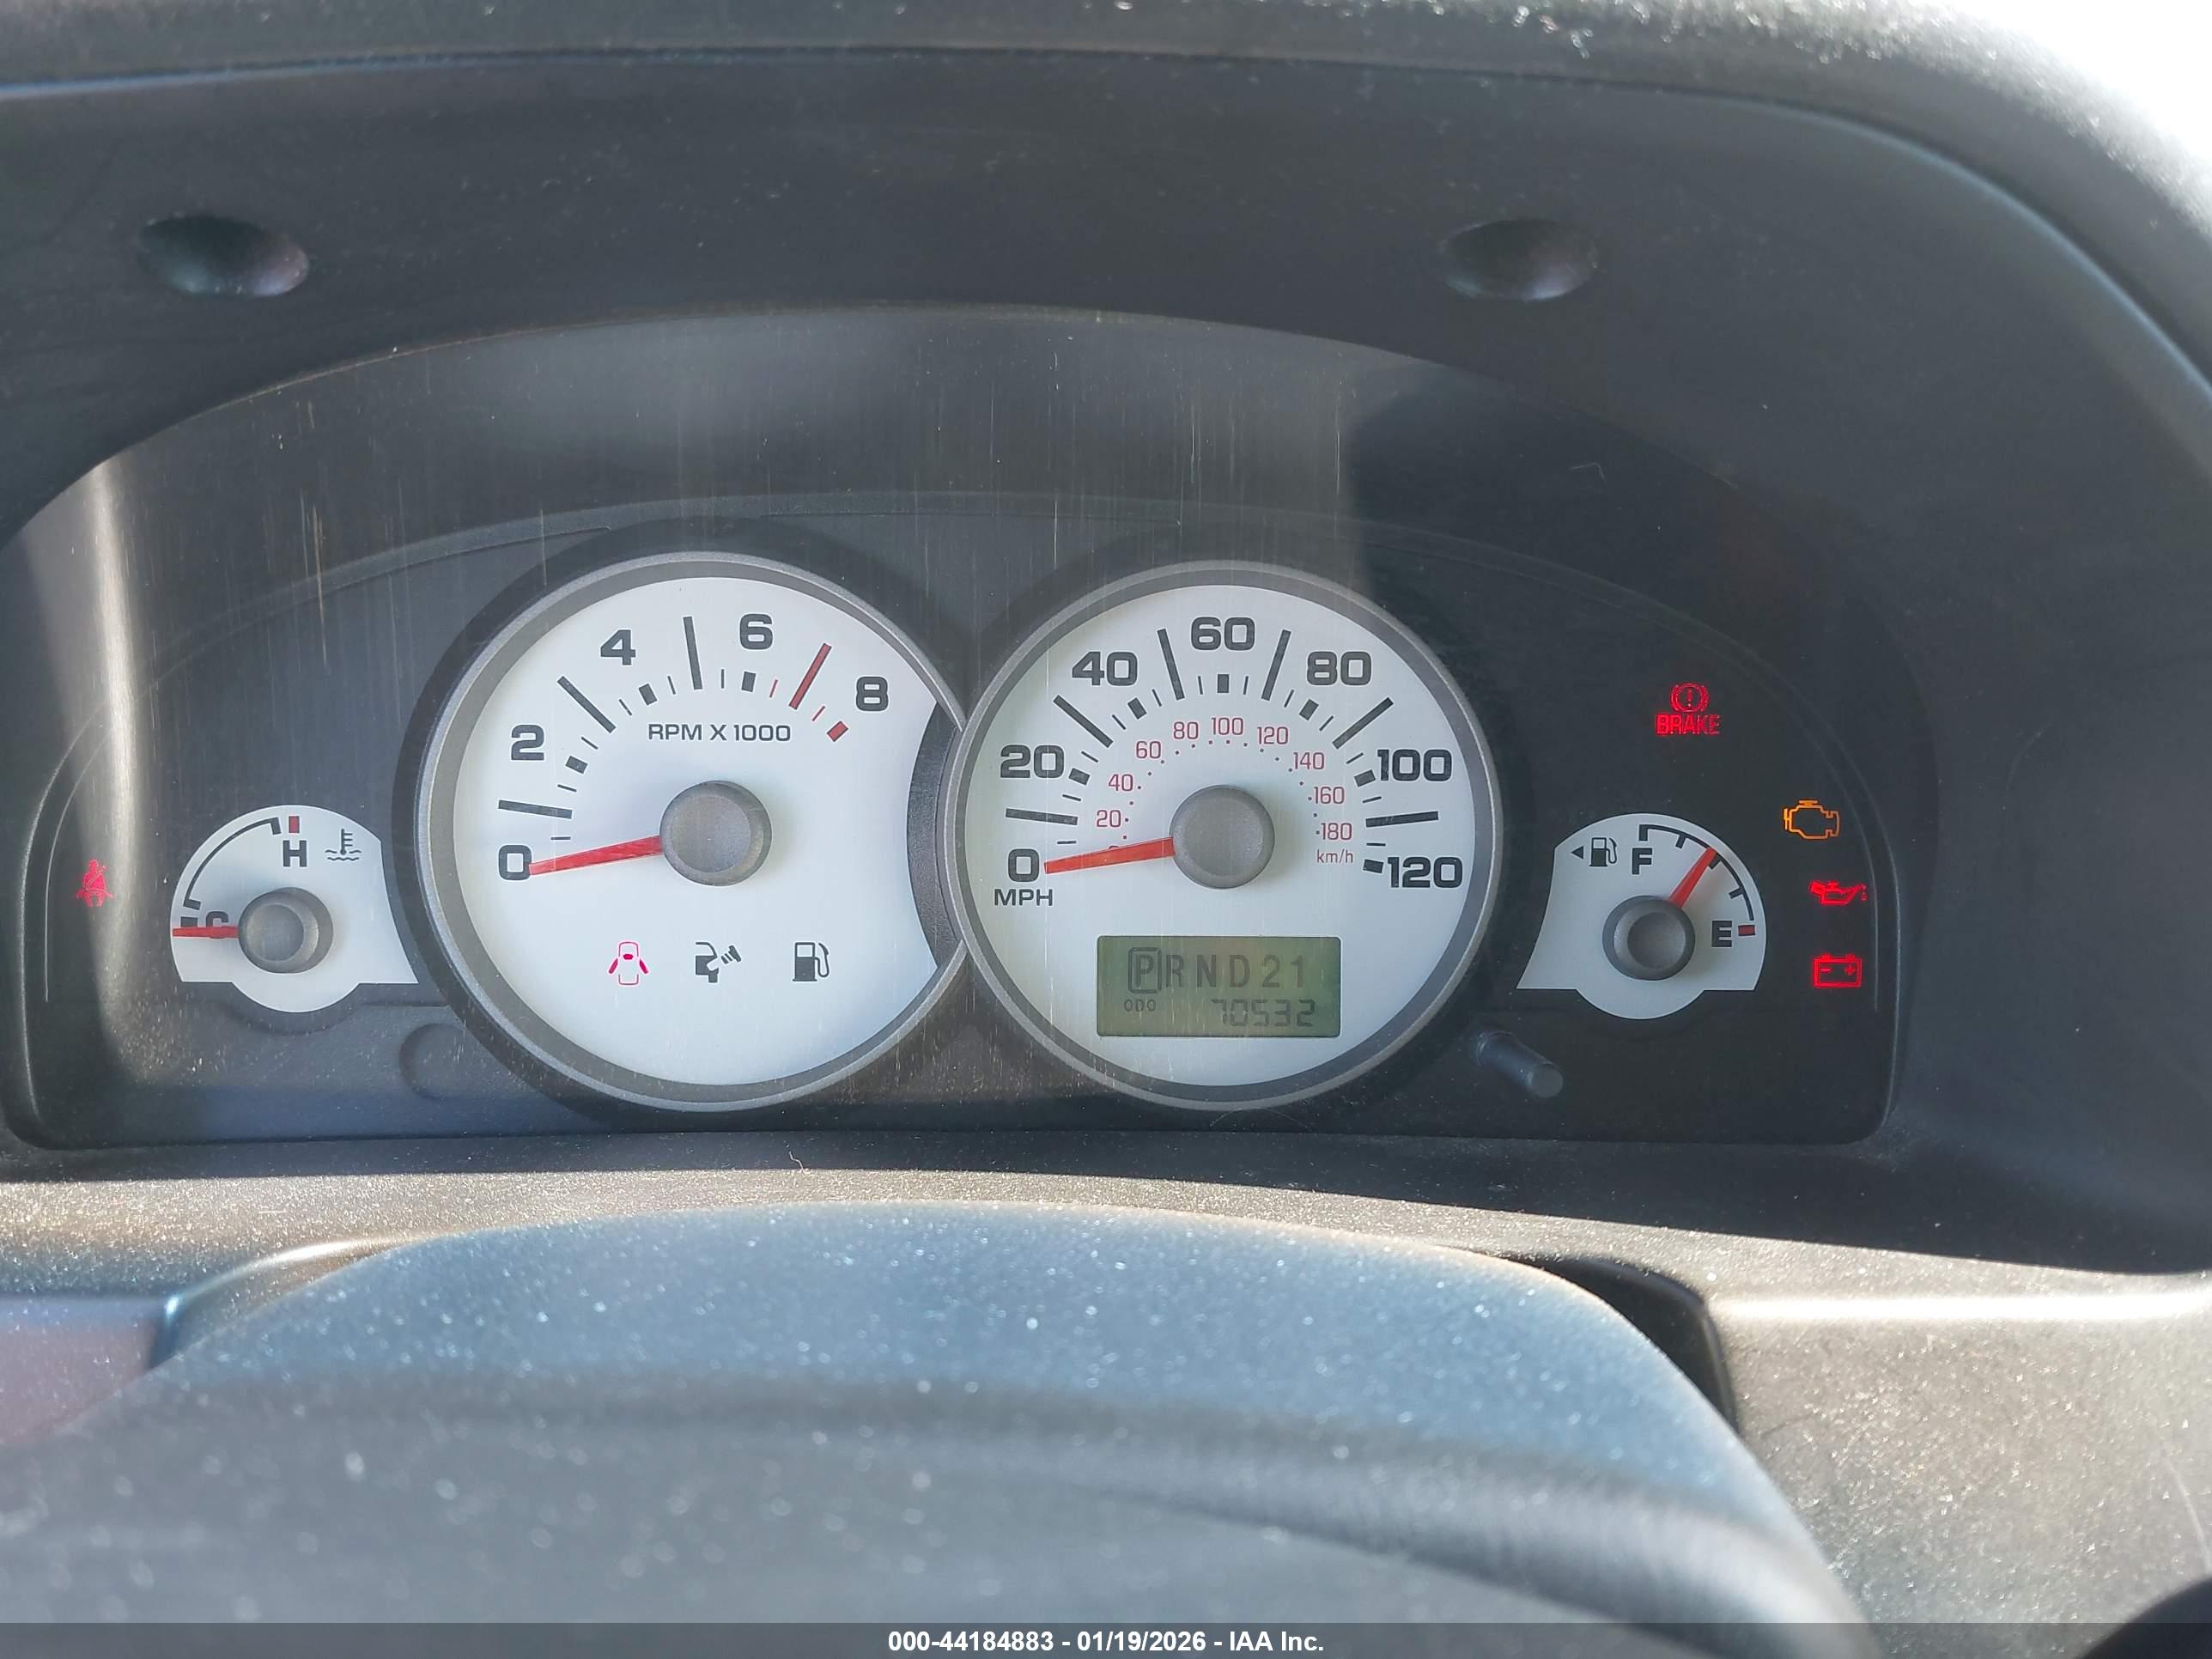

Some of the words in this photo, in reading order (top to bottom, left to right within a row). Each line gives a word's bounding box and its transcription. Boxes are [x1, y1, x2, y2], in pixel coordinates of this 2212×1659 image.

[739, 614, 774, 650] 6
[1190, 617, 1255, 652] 60
[600, 629, 637, 665] 4
[1071, 651, 1139, 687] 40
[1306, 651, 1372, 687] 80
[855, 677, 889, 712] 8
[647, 723, 704, 742] RPM
[709, 723, 728, 742] X
[732, 723, 792, 743] 1000
[1173, 720, 1200, 741] 80
[1211, 716, 1244, 737] 100
[1257, 726, 1289, 745] 120
[1655, 714, 1721, 735] BRAKE
[511, 724, 545, 762] 2
[1134, 740, 1163, 760] 60
[1000, 744, 1065, 780] 20
[1293, 751, 1326, 771] 140
[1376, 748, 1453, 783] 100
[1108, 774, 1134, 793] 40
[1313, 786, 1346, 805] 160
[1095, 809, 1122, 830] 20
[1320, 822, 1353, 842] 180
[282, 839, 307, 867] H
[498, 844, 532, 881] 0
[1007, 848, 1041, 884] 0
[1316, 848, 1355, 865] km/h
[1632, 847, 1653, 875] F
[1387, 855, 1463, 890] 120
[994, 888, 1054, 908] MPH
[1711, 920, 1733, 948] E
[1123, 999, 1157, 1012] ODO
[1211, 999, 1316, 1027] 70532
